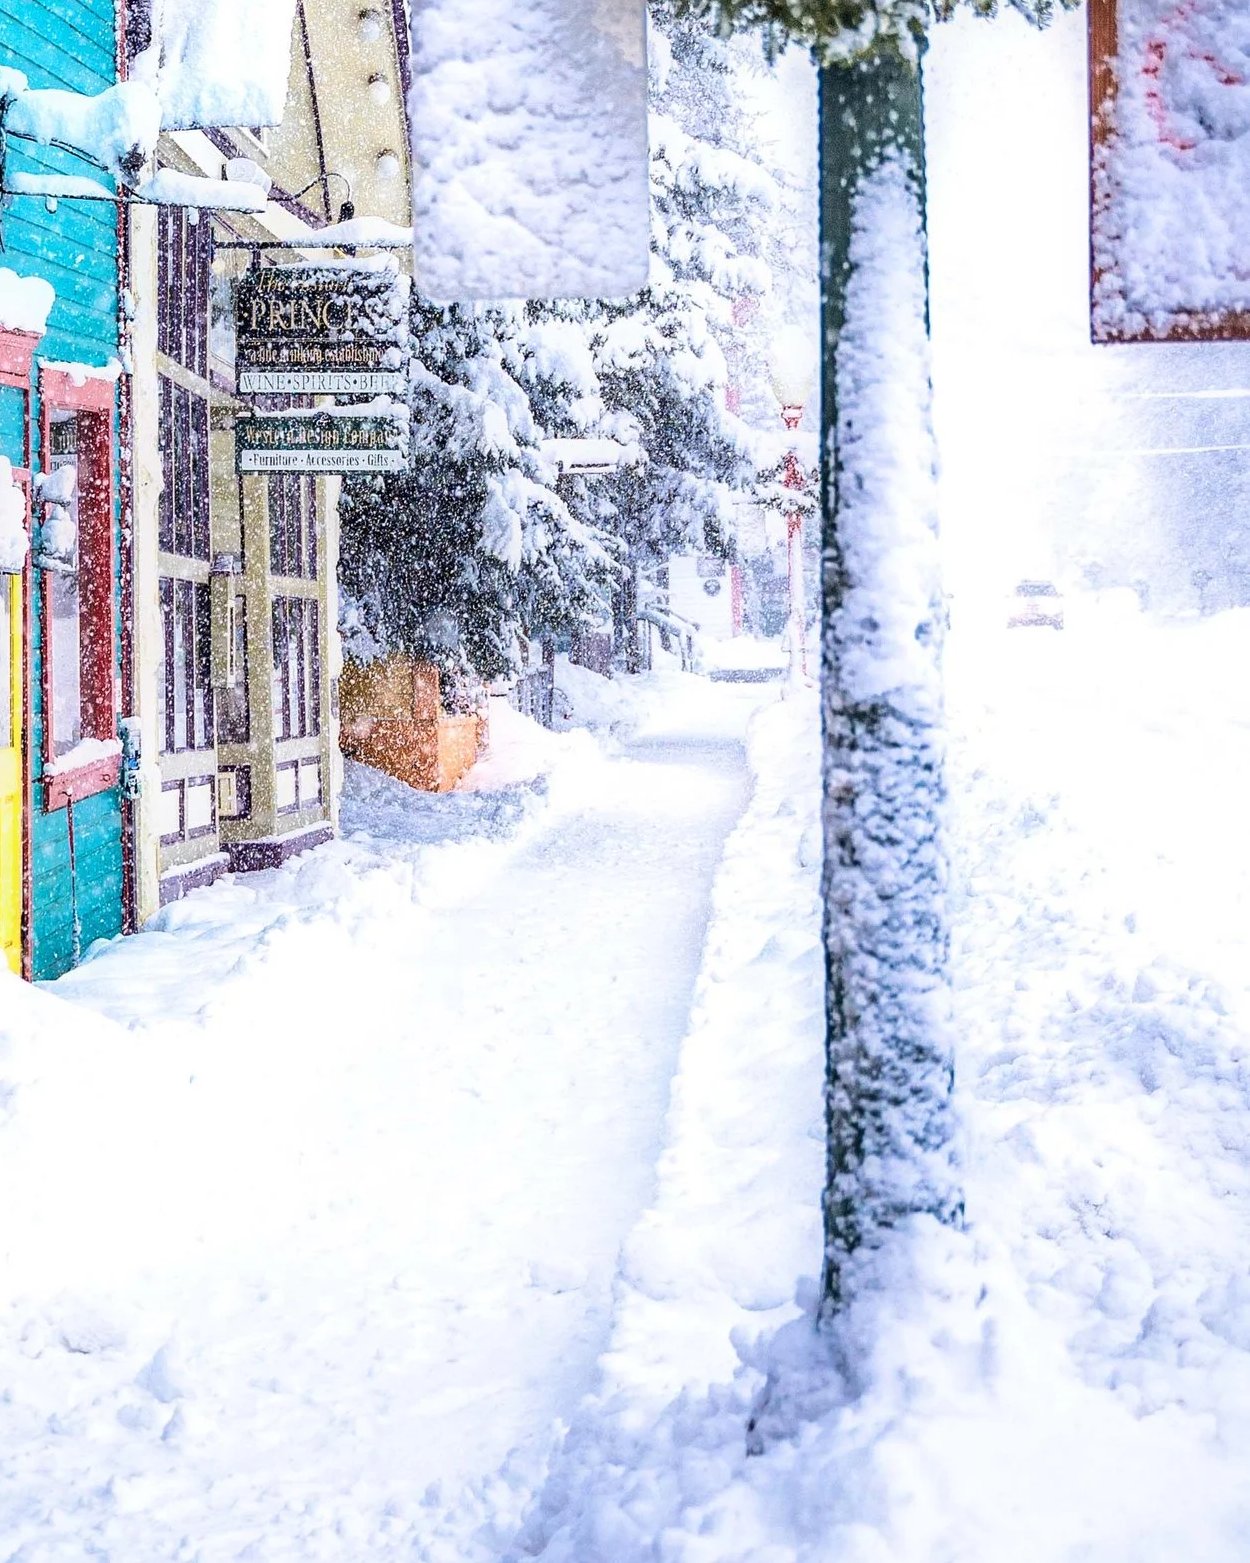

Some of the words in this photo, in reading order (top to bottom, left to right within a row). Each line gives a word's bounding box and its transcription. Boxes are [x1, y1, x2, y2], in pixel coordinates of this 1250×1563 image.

[242, 374, 286, 390] WINE
[292, 374, 354, 390] SPIRITS
[359, 374, 396, 390] BEE
[252, 453, 298, 467] Furniture
[306, 453, 360, 467] Accessories
[366, 453, 389, 467] Gifts
